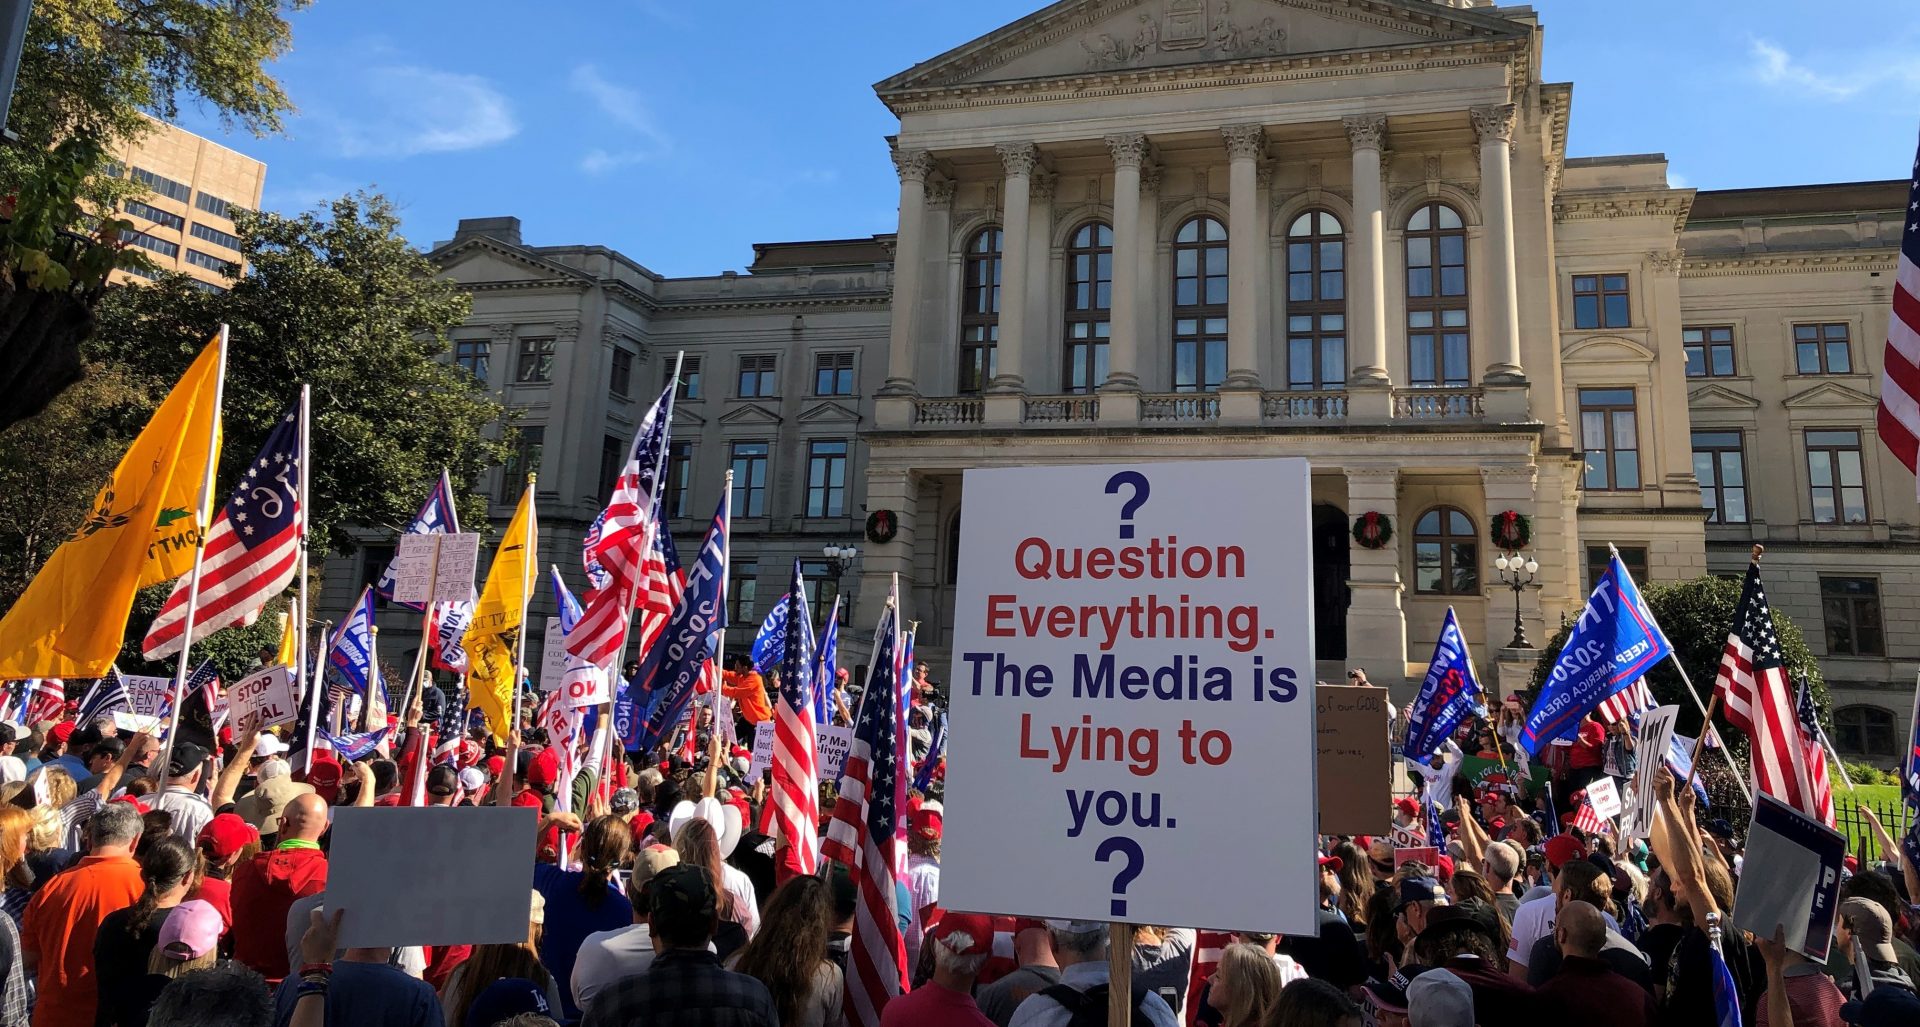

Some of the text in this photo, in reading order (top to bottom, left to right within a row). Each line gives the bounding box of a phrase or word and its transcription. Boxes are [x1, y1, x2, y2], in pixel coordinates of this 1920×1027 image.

[1104, 470, 1151, 539] ?
[1015, 535, 1245, 580] Question
[986, 594, 1275, 652] Everything.
[129, 679, 162, 691] EGAL
[237, 676, 273, 702] STOP
[963, 652, 1298, 703] The Media is
[1409, 624, 1461, 746] TRUMP
[243, 692, 267, 713] THE
[1317, 696, 1333, 714] of
[1337, 704, 1355, 712] our
[759, 726, 774, 739] Every
[1020, 713, 1233, 776] Lying to
[1066, 789, 1177, 837] you.
[1391, 826, 1422, 848] TOP
[1094, 836, 1145, 917] ?
[530, 989, 549, 1012] LA
